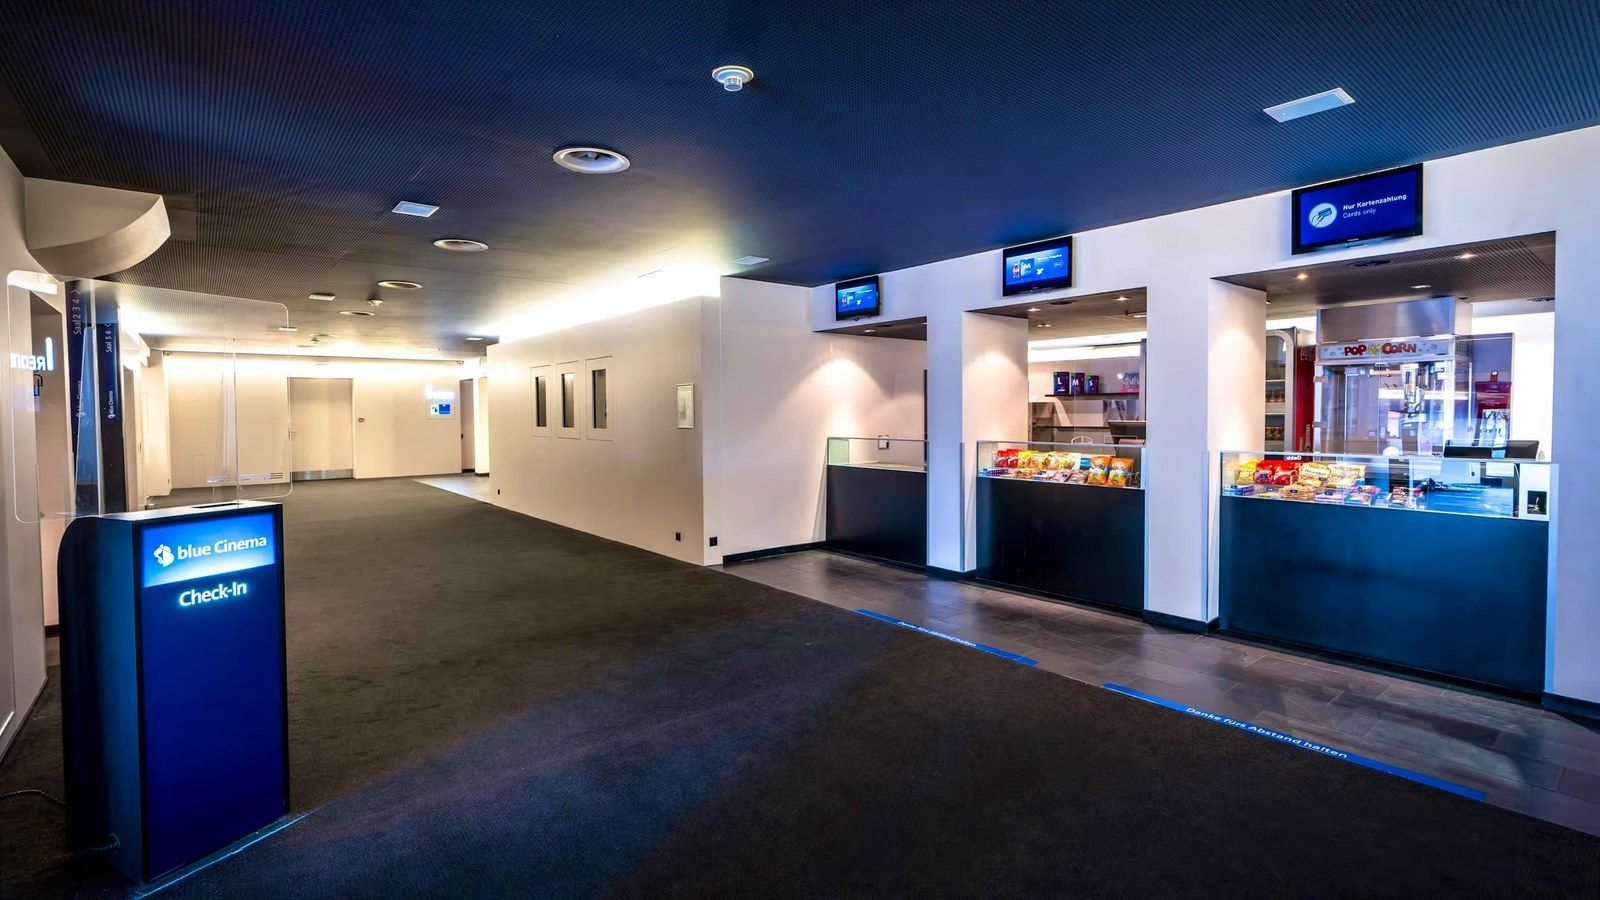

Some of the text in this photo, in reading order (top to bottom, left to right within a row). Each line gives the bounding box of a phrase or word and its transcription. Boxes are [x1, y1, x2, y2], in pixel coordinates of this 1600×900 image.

[1357, 195, 1407, 208] Kartenzahlung
[1342, 208, 1377, 219] Cards only
[72, 319, 82, 335] Saal
[104, 341, 113, 353] Saal
[1344, 342, 1417, 356] POP CORN
[1057, 377, 1062, 385] L
[177, 536, 267, 559] blue Cinema
[179, 582, 247, 605] Check-In
[1185, 707, 1348, 758] Danke fürs Abstand halten
